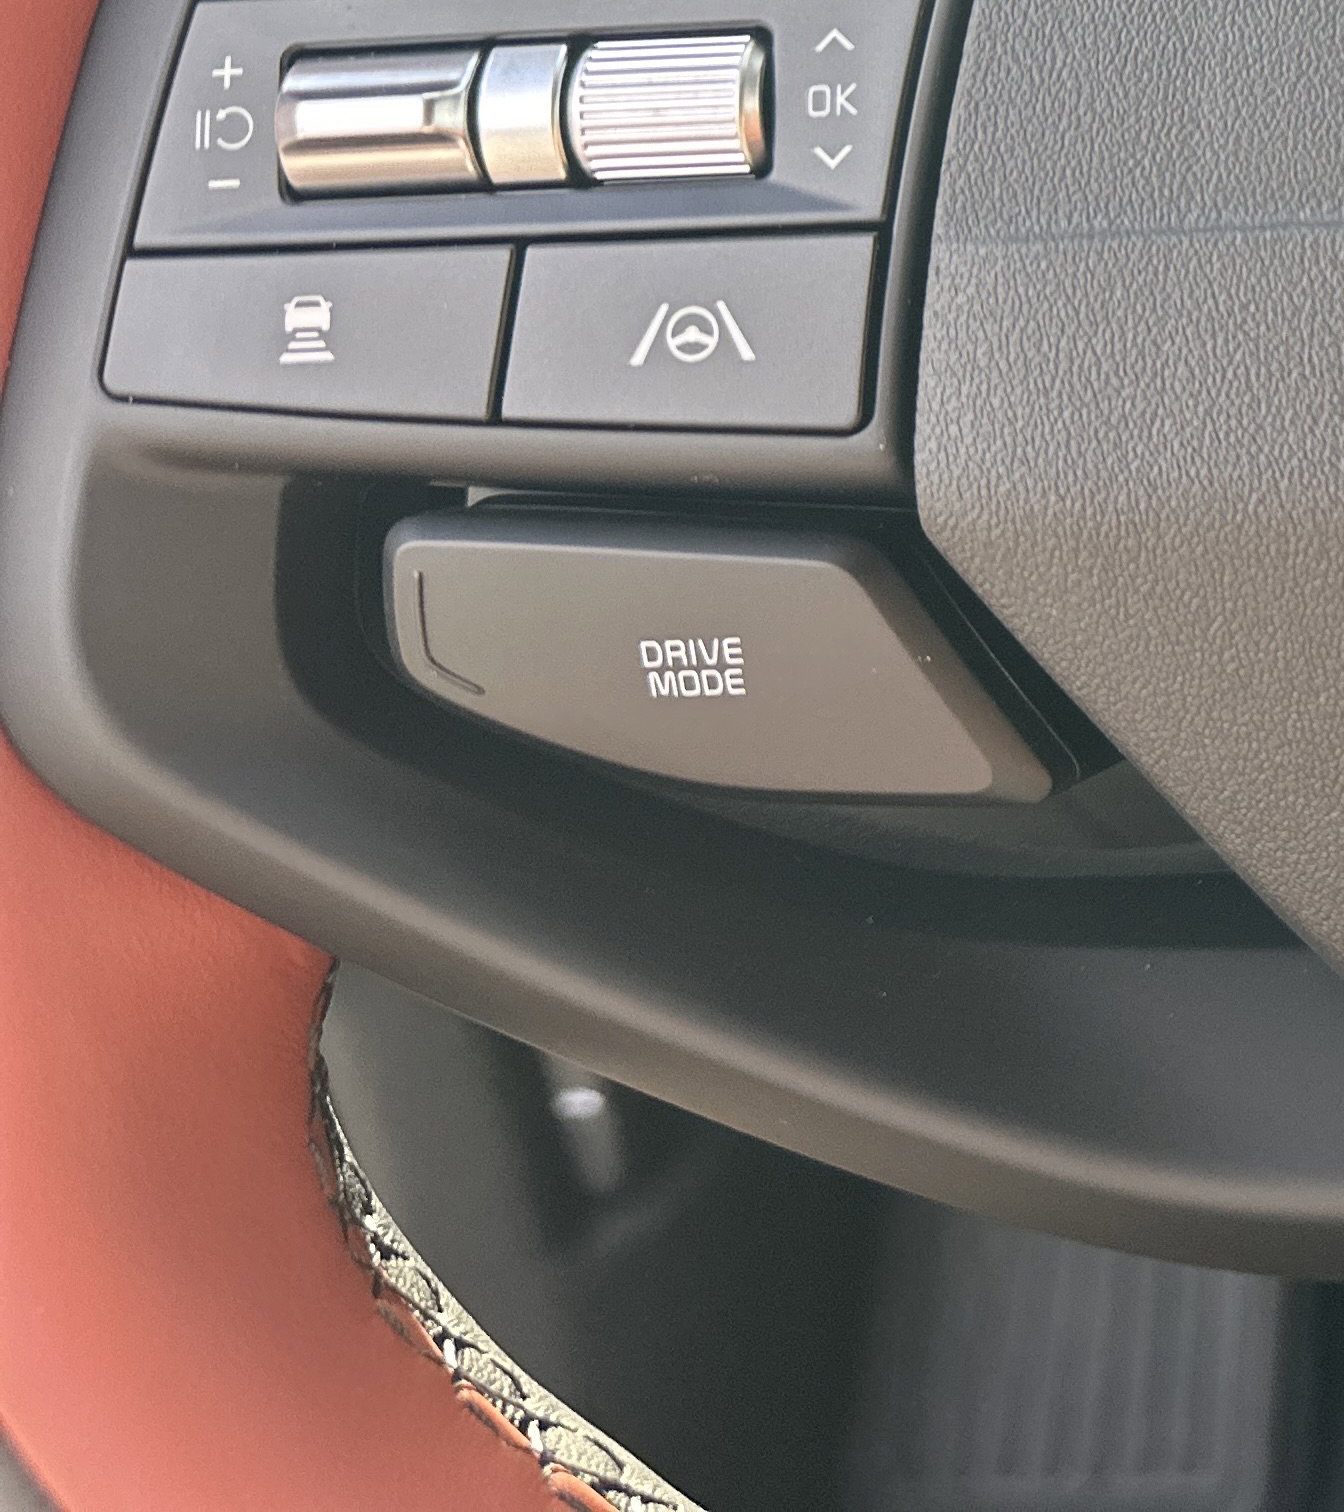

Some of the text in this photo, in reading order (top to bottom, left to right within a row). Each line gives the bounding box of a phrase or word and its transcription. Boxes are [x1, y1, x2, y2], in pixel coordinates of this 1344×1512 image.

[807, 82, 858, 118] OK
[639, 636, 745, 668] DRIVE
[647, 668, 747, 698] MODE
